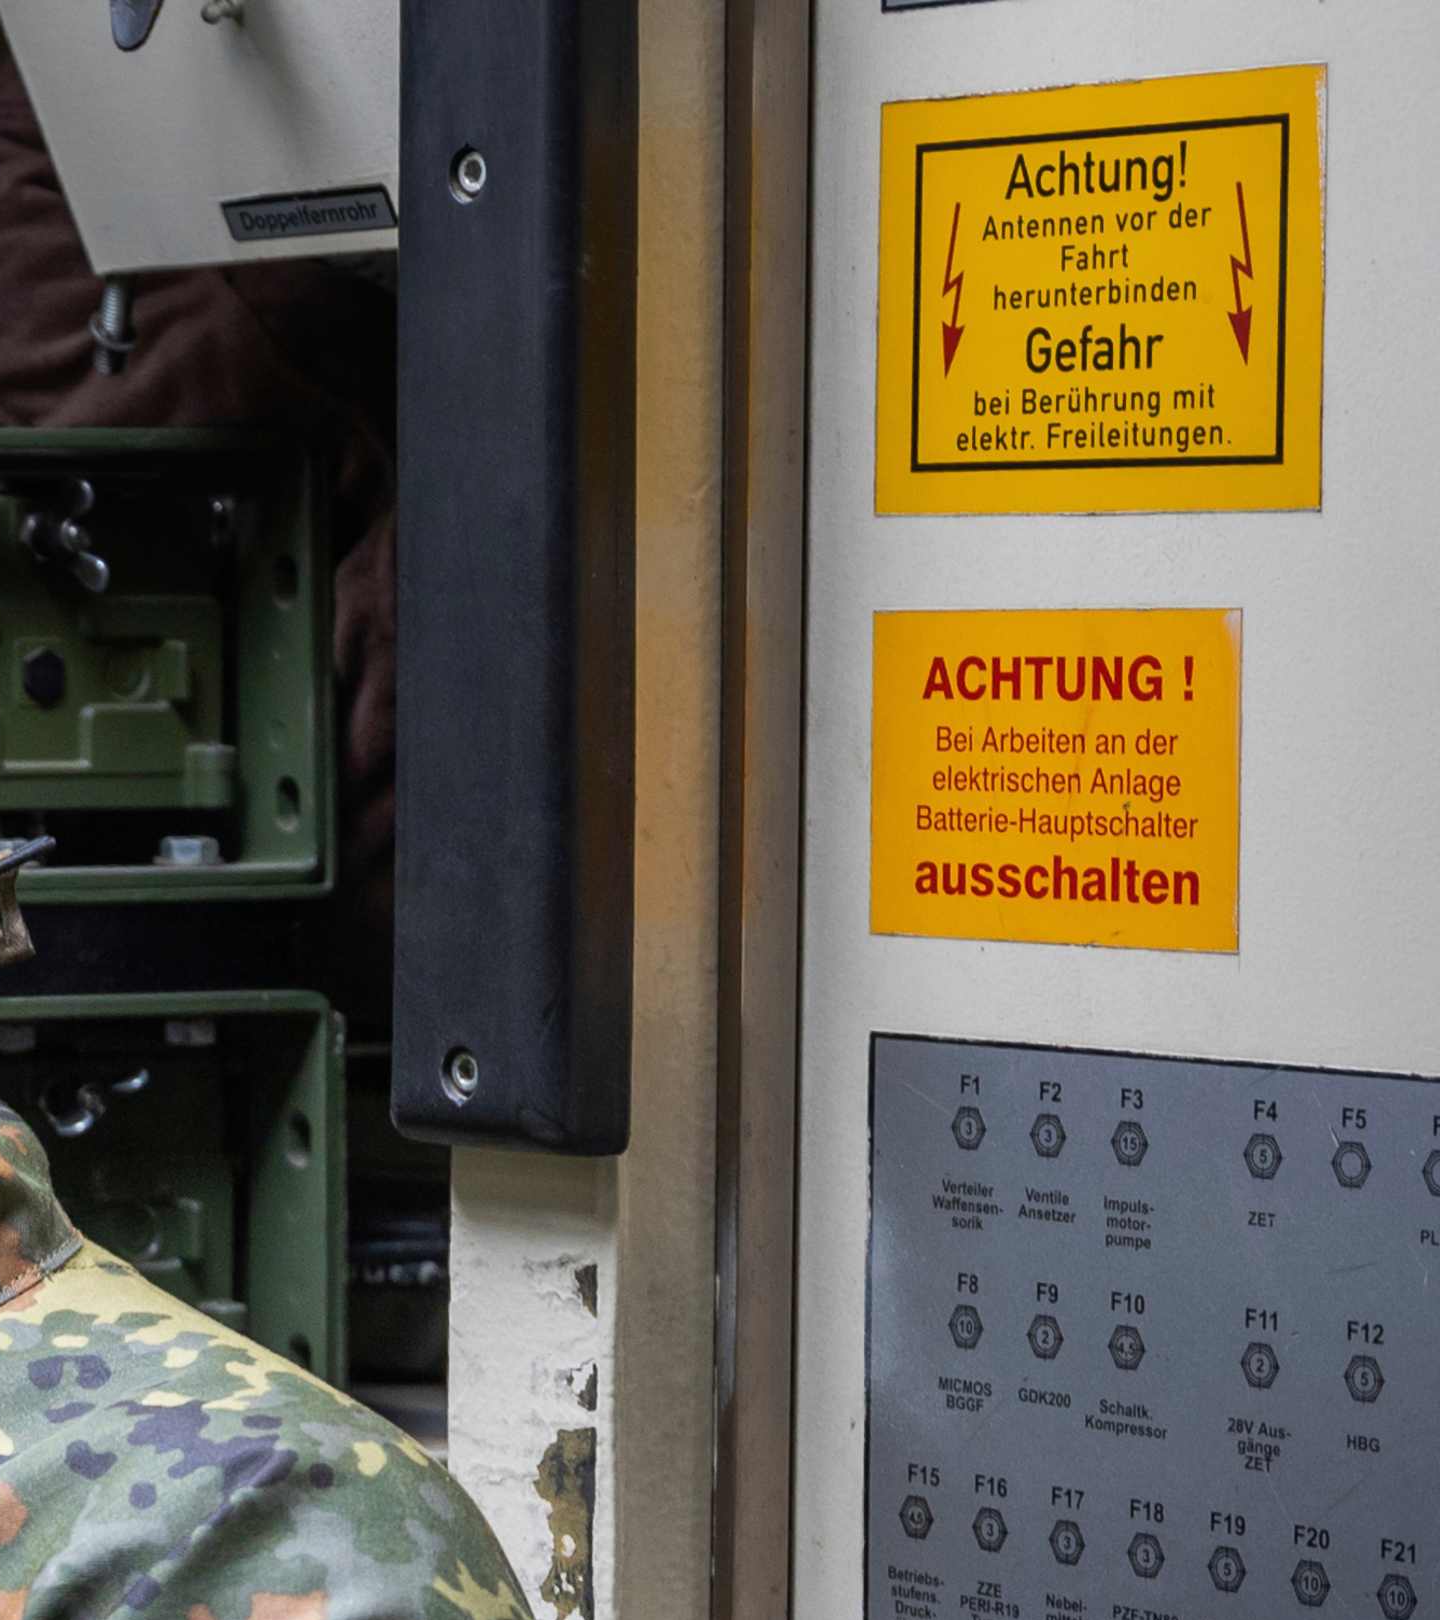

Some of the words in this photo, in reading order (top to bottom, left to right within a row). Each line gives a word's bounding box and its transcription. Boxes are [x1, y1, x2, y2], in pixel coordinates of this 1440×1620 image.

[1005, 141, 1188, 201] Achtung!
[240, 201, 377, 231] Doppelfernrohr
[982, 213, 1104, 240] Antennen
[1115, 210, 1157, 231] vor
[1169, 203, 1212, 228] der
[1061, 244, 1129, 271] Fahrt
[994, 277, 1197, 310] herunterbinden
[1026, 324, 1164, 373] Gefahr
[974, 391, 1009, 416] bei
[1022, 387, 1160, 417] Berührung
[1174, 384, 1215, 410] mit
[956, 427, 1034, 451] elektr.
[1047, 421, 1232, 452] Freileitungen.
[922, 655, 1163, 701] ACHTUNG
[936, 726, 973, 752] Bei
[982, 727, 1085, 754] Arbeiten
[1095, 732, 1125, 754] an
[1135, 729, 1178, 755] der
[932, 766, 1080, 793] elektrischen
[1090, 768, 1181, 802] Anlage
[917, 805, 1198, 841] Batterie-Hauptschalter
[915, 856, 1199, 905] ausschalten
[960, 1075, 980, 1095] F1
[1039, 1082, 1061, 1102] F2
[1121, 1088, 1143, 1110] F3
[1254, 1100, 1278, 1121] F4
[1342, 1108, 1366, 1129] F5
[965, 1121, 972, 1135] 3
[1044, 1129, 1052, 1143] 3
[1123, 1136, 1137, 1151] 15
[1259, 1149, 1267, 1164] 5
[942, 1179, 994, 1197] Verteiler
[1025, 1188, 1070, 1205] Ventile
[932, 1195, 1004, 1215] Waffensen-
[1018, 1205, 1076, 1223] Ansetzer
[1104, 1197, 1155, 1214] Impuls-
[952, 1216, 983, 1230] sorik
[1106, 1217, 1151, 1231] motor-
[1248, 1212, 1275, 1227] ZET
[1105, 1235, 1151, 1250] pumpe
[957, 1273, 979, 1294] F8
[1037, 1283, 1059, 1303] F9
[1111, 1292, 1145, 1314] F10
[960, 1321, 972, 1334] 10
[1245, 1308, 1278, 1331] F11
[1041, 1332, 1049, 1344] 2
[1347, 1321, 1384, 1344] F12
[1256, 1359, 1264, 1372] 2
[938, 1377, 992, 1396] MICMOS
[1360, 1372, 1369, 1386] 5
[946, 1397, 984, 1412] BGGF
[1018, 1388, 1071, 1408] GDK200
[1100, 1400, 1152, 1420] Schaltk.
[1085, 1416, 1167, 1440] Kompressor
[1228, 1418, 1254, 1433] 28V
[1258, 1422, 1292, 1438] Aus-
[1238, 1440, 1280, 1457] gänge
[1347, 1435, 1381, 1452] HBG
[1245, 1457, 1272, 1472] ZET
[908, 1464, 939, 1487] F15
[975, 1475, 1007, 1498] F16
[1052, 1487, 1084, 1509] F17
[1130, 1499, 1164, 1523] F18
[986, 1524, 994, 1536] 3
[1211, 1512, 1245, 1536] F19
[1063, 1536, 1071, 1549] 3
[1294, 1525, 1329, 1549] F20
[1142, 1550, 1150, 1562] 3
[1381, 1539, 1415, 1564] F21
[888, 1566, 944, 1587] Betriebs-
[1223, 1563, 1231, 1576] 5
[892, 1584, 941, 1603] stufens.
[977, 1582, 1002, 1597] ZZE
[1304, 1577, 1319, 1590] 10
[960, 1595, 1020, 1618] PERI-R19
[1046, 1594, 1087, 1612] Nebel-
[1390, 1591, 1405, 1605] 10
[896, 1600, 937, 1619] Druck-
